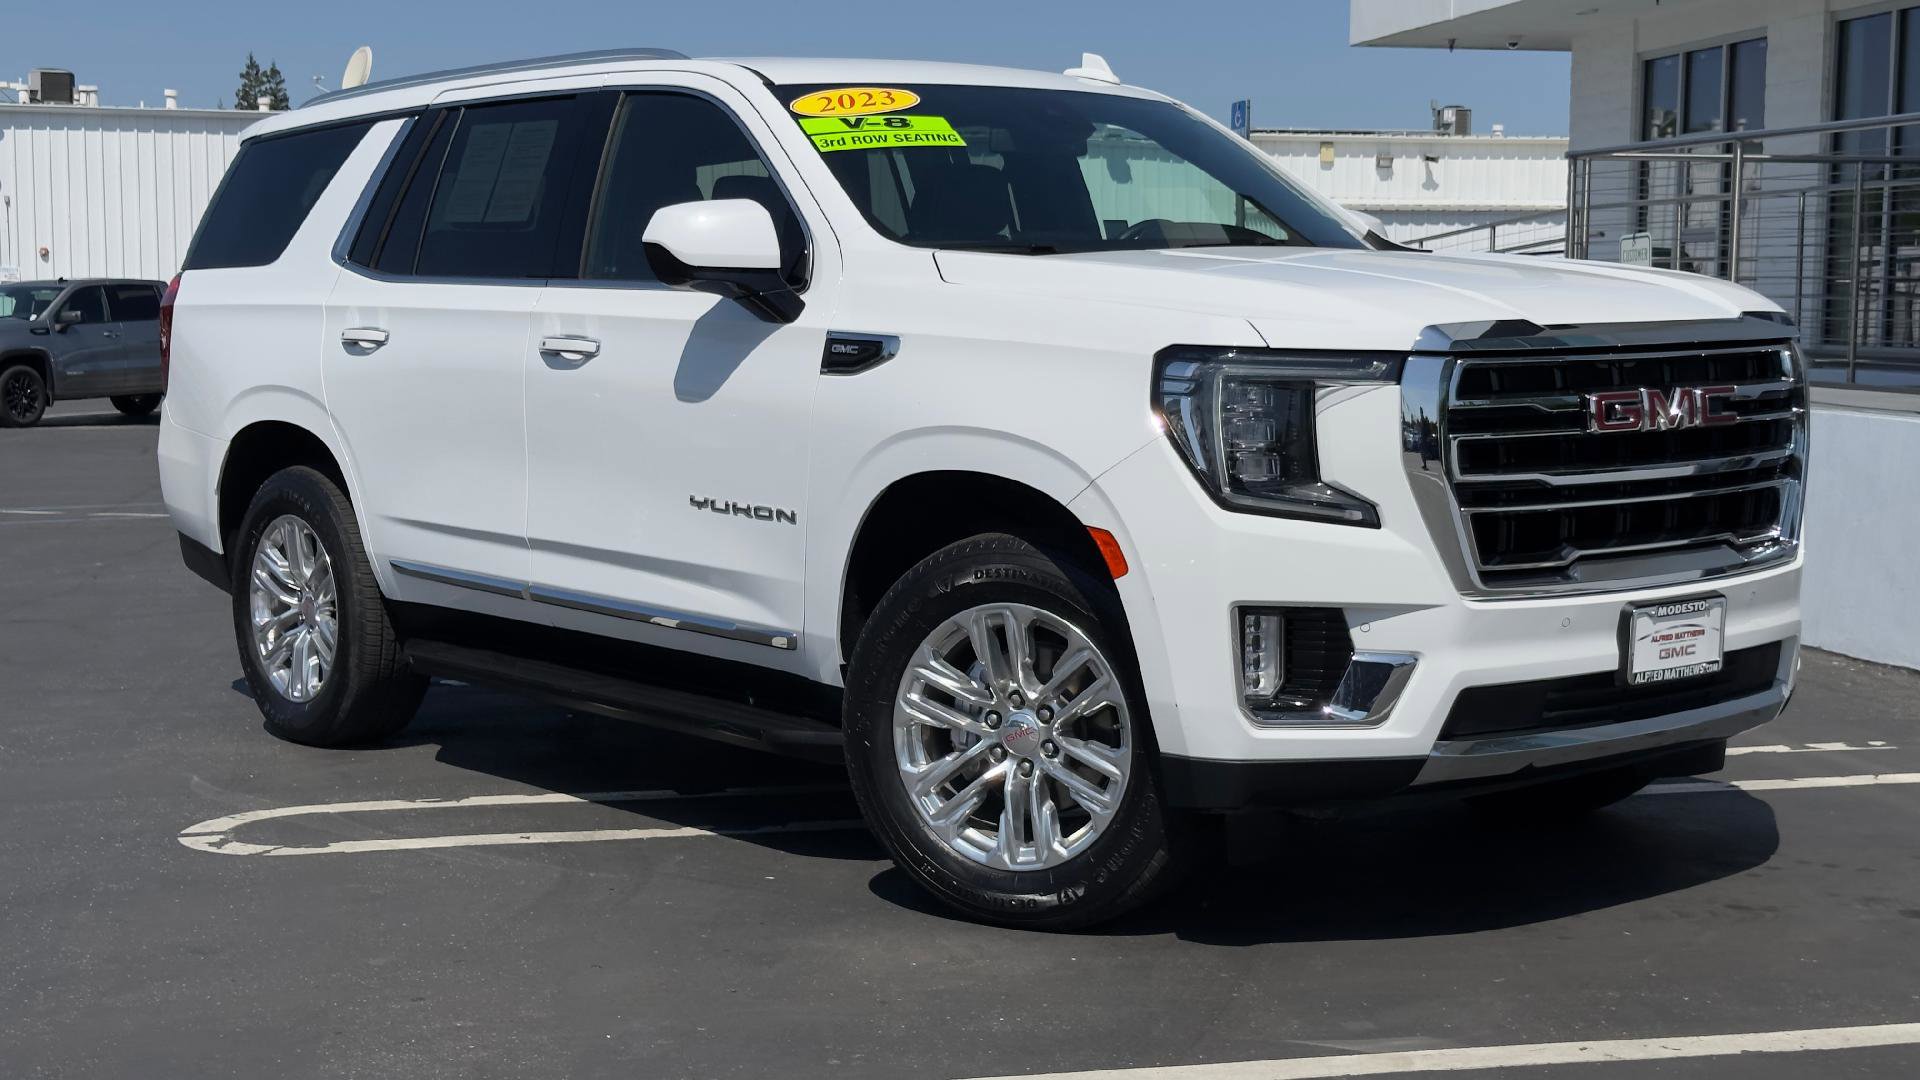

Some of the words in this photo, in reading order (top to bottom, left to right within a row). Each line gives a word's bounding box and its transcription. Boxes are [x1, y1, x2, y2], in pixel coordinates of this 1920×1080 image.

[817, 90, 896, 113] 2023
[839, 117, 914, 130] V-8
[819, 138, 846, 149] 3rd
[852, 134, 888, 145] ROW
[894, 133, 959, 143] SEATING
[831, 344, 859, 354] GMC
[1588, 385, 1738, 434] GMC
[689, 494, 797, 526] YUKON
[1657, 601, 1706, 617] MODESTO
[1659, 644, 1696, 660] GMC
